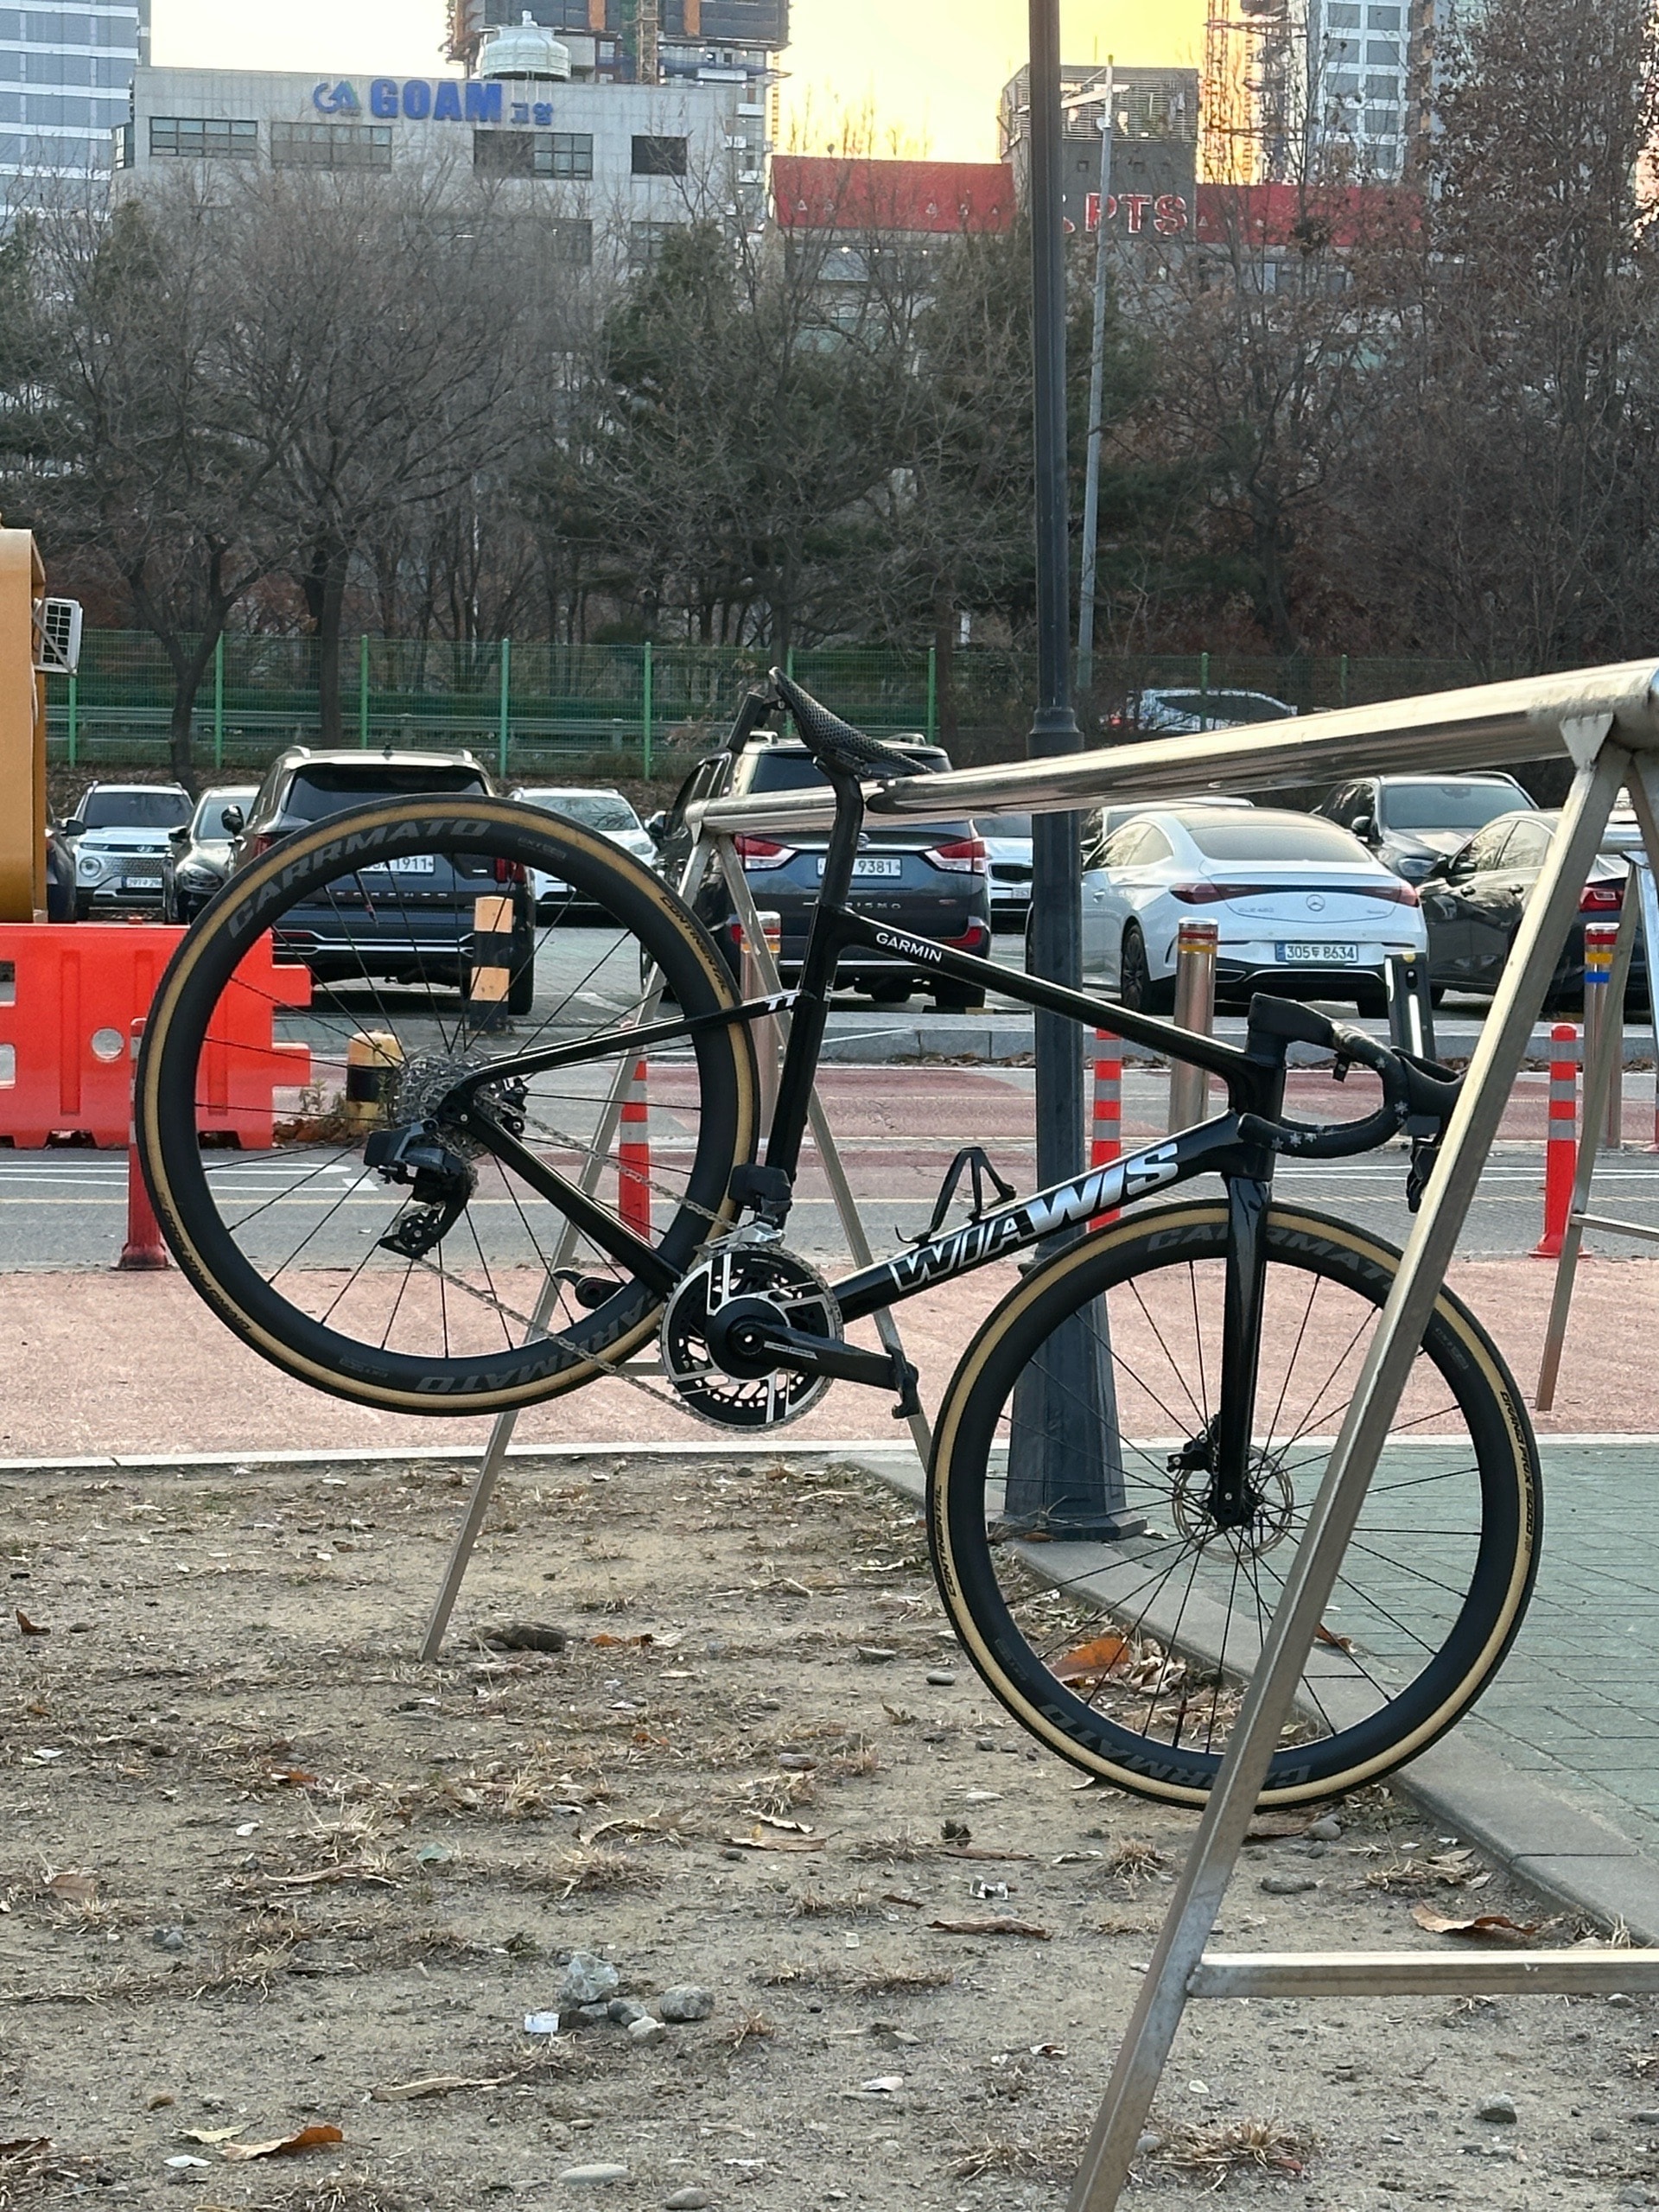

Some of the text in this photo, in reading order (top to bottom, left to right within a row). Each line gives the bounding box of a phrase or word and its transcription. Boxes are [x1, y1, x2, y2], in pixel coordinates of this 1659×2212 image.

[370, 78, 503, 123] GOAM
[510, 100, 554, 125] 고암
[857, 860, 893, 874] 9381
[876, 931, 943, 963] GARMIN
[888, 1143, 1179, 1293] WIAWIS
